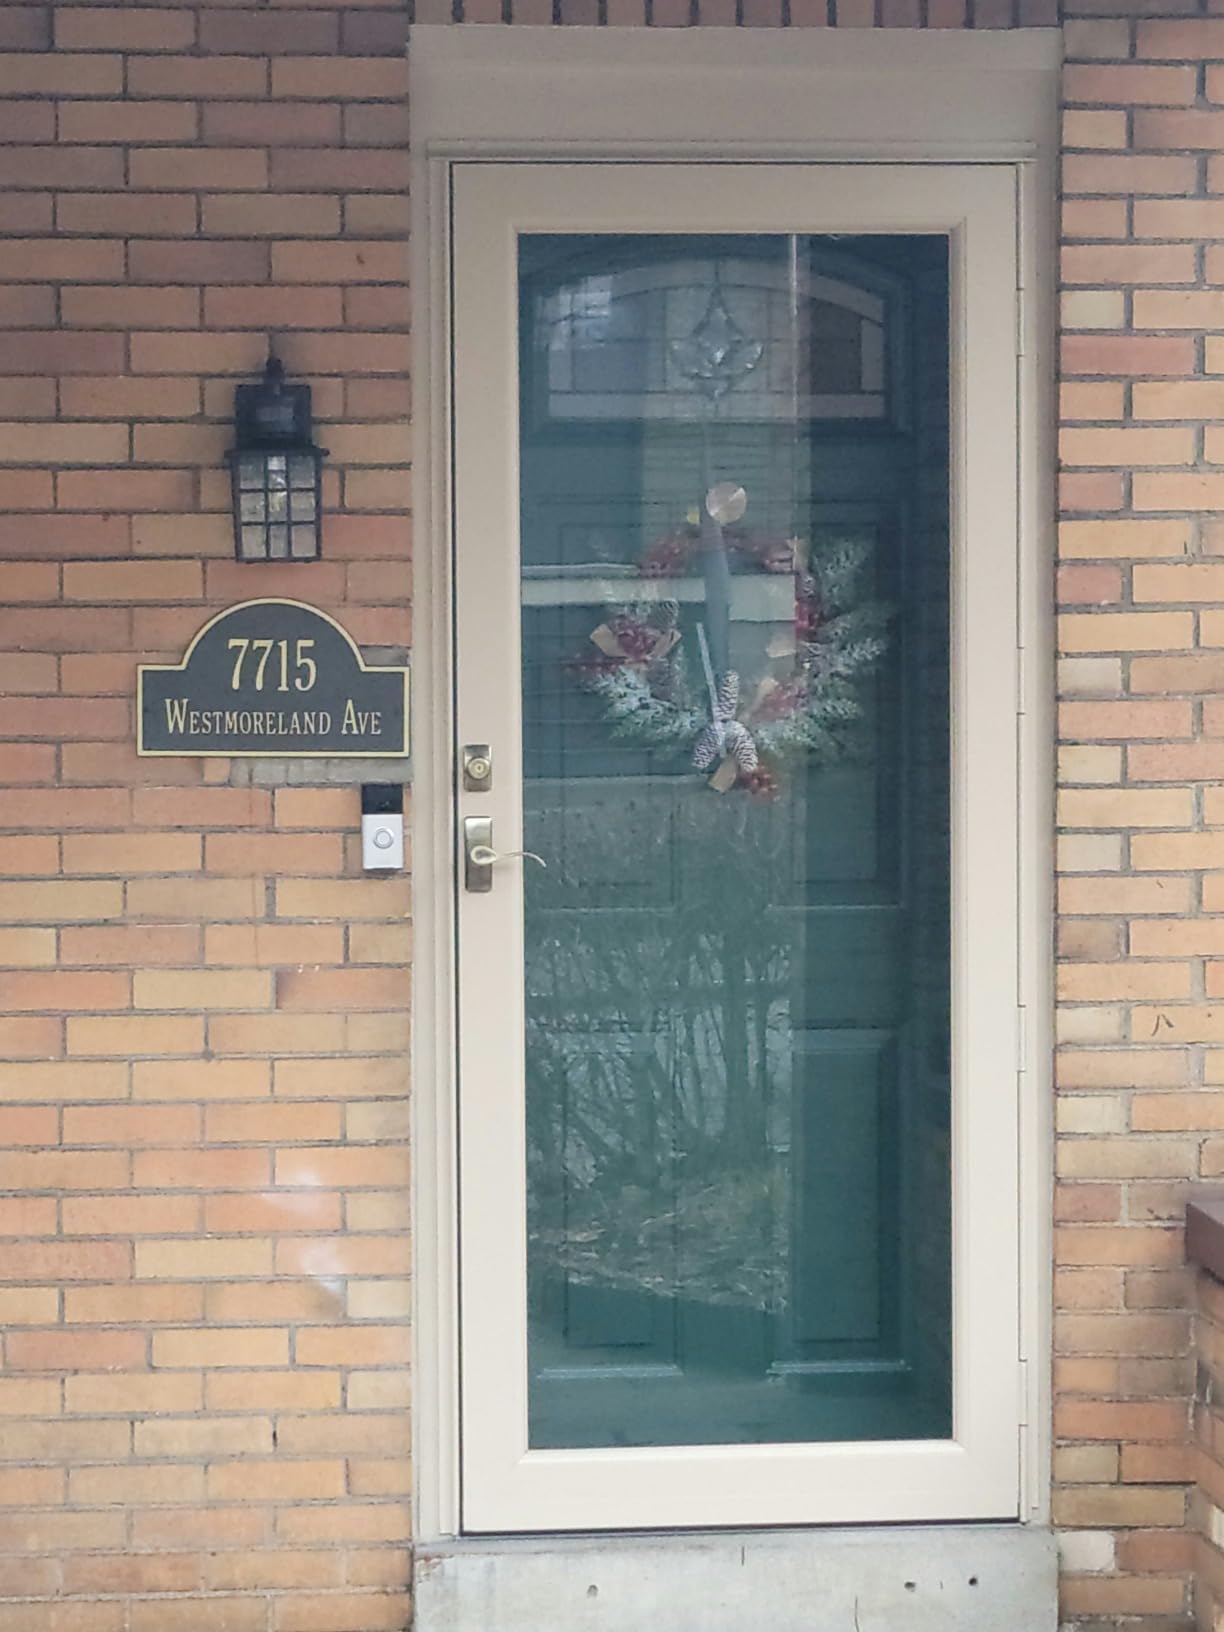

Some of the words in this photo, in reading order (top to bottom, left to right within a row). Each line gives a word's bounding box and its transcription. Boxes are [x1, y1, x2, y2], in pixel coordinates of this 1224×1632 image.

[227, 638, 317, 692] 7715
[164, 698, 331, 735] WESTMORELAND
[340, 698, 382, 735] AVE
